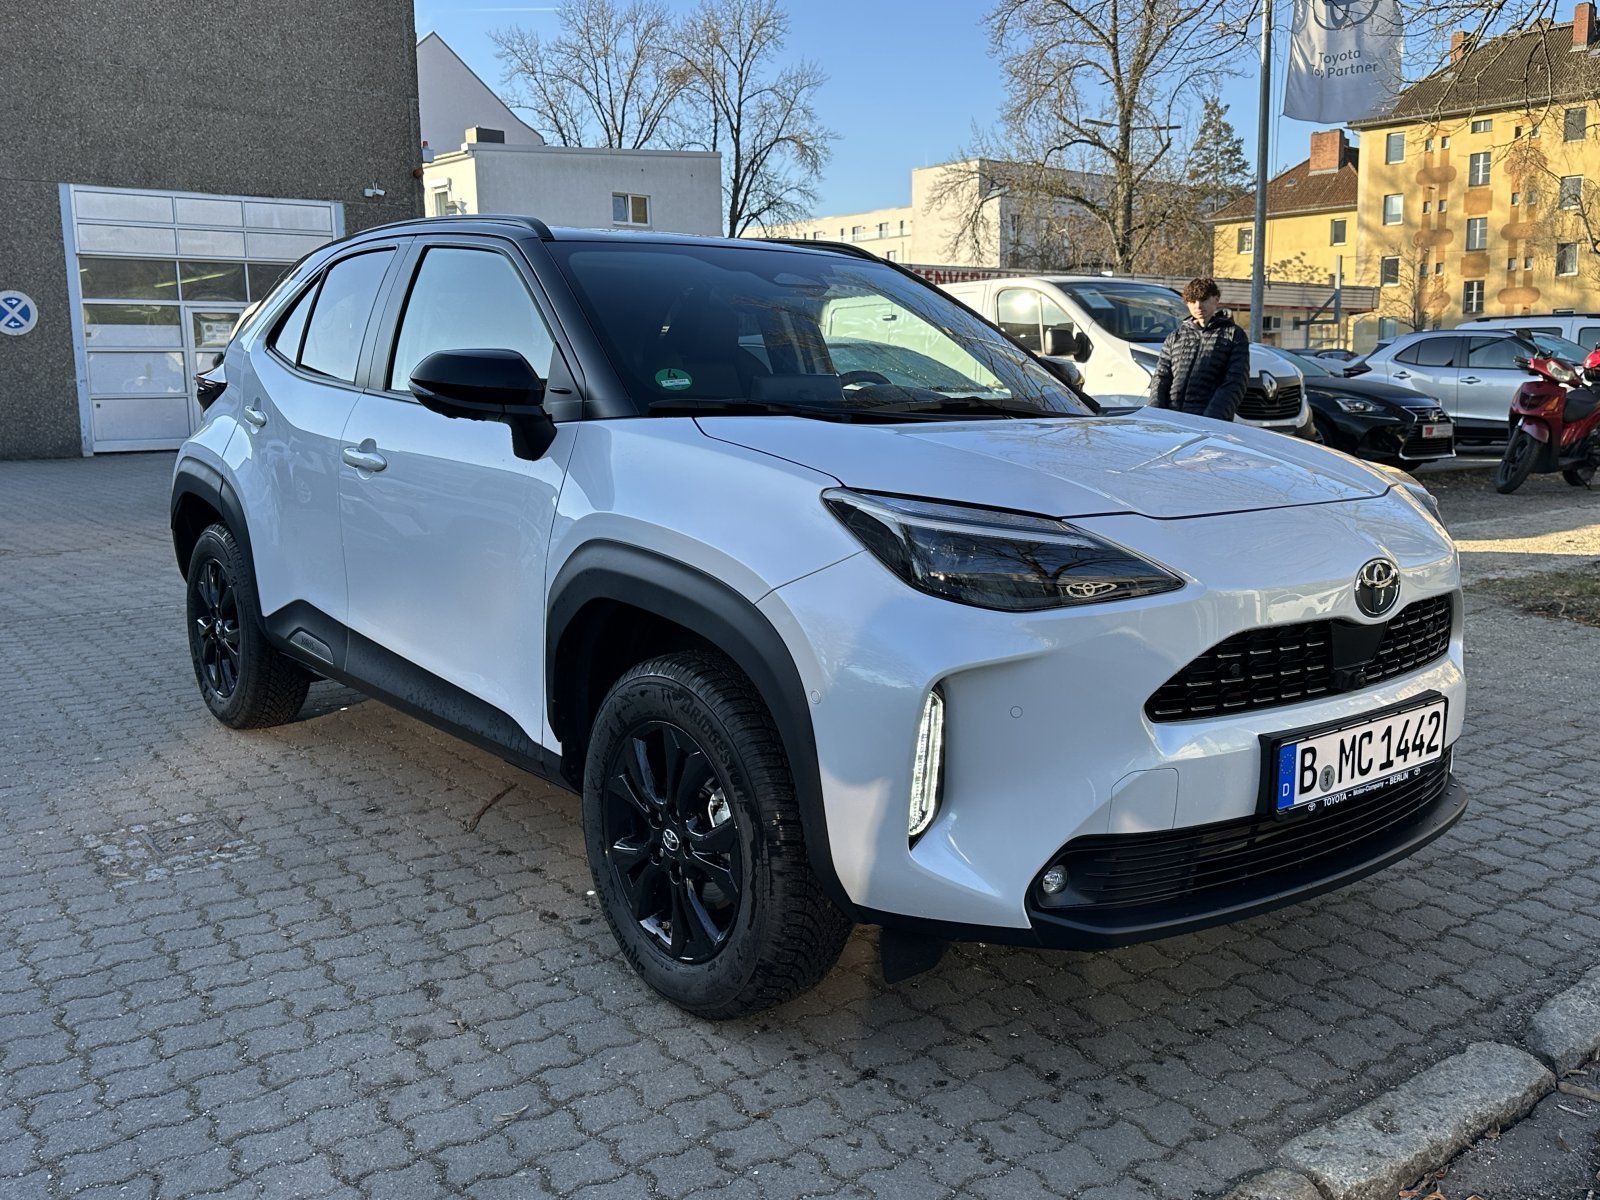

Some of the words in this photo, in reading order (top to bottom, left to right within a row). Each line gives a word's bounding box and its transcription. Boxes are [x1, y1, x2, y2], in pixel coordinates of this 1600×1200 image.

[1318, 49, 1361, 66] Toyota
[1327, 63, 1378, 78] Partner
[1299, 746, 1318, 795] B
[1282, 783, 1290, 797] D
[1323, 793, 1347, 807] TOYOTA
[1389, 771, 1409, 785] BERLIN
